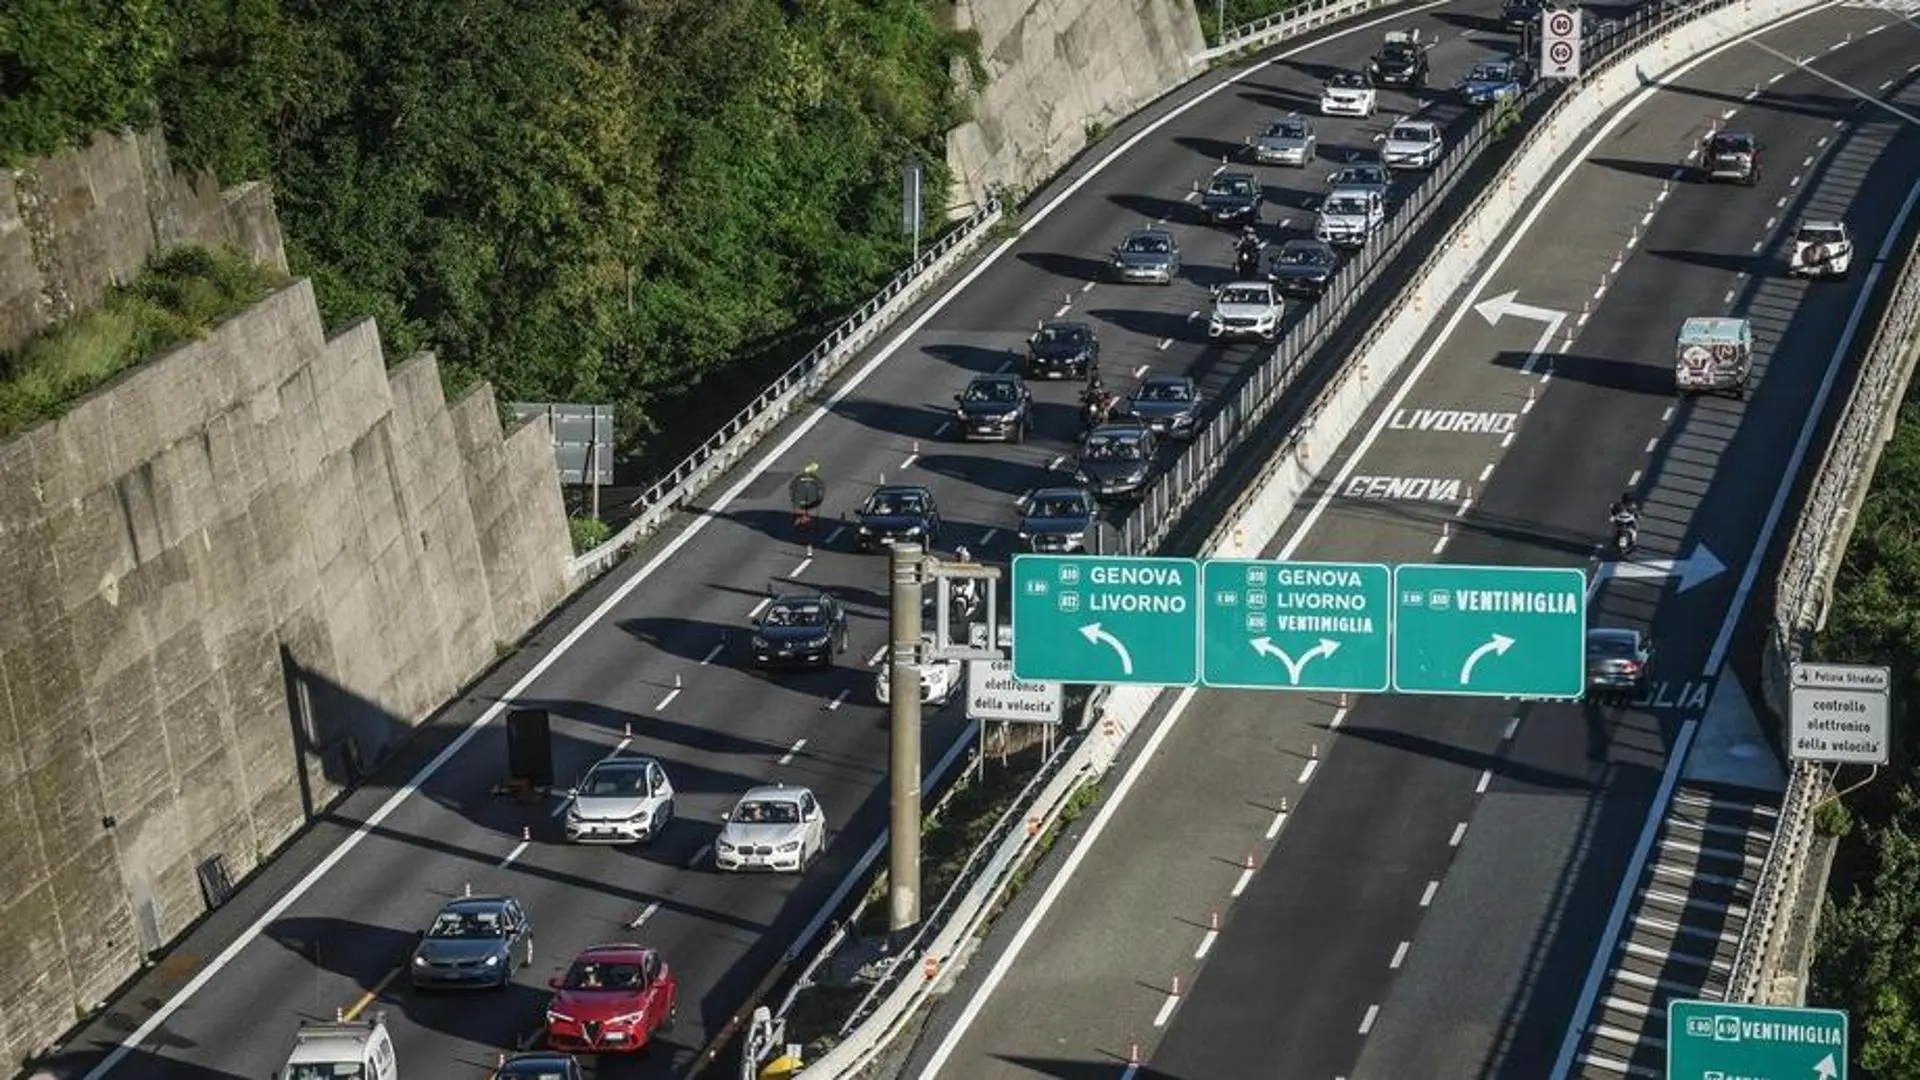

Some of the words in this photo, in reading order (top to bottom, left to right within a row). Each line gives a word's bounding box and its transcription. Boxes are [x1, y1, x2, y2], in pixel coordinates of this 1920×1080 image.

[1388, 408, 1518, 434] LIVORNO
[1343, 475, 1462, 501] GENOVA
[1090, 567, 1182, 586] GENOVA
[1278, 570, 1362, 587] GENOVA
[1089, 594, 1186, 613] LIVORNO
[1277, 594, 1366, 611] LIVORNO
[1456, 589, 1577, 615] VENTIMIGLIA
[1277, 615, 1373, 634] VENTIMIGLIA
[985, 678, 1046, 693] elettronico
[974, 696, 1003, 709] della
[1813, 700, 1866, 712] controllo
[1807, 718, 1870, 733] elettronico
[1798, 738, 1827, 751] della
[1742, 1021, 1842, 1045] VENTIMIGLIA
